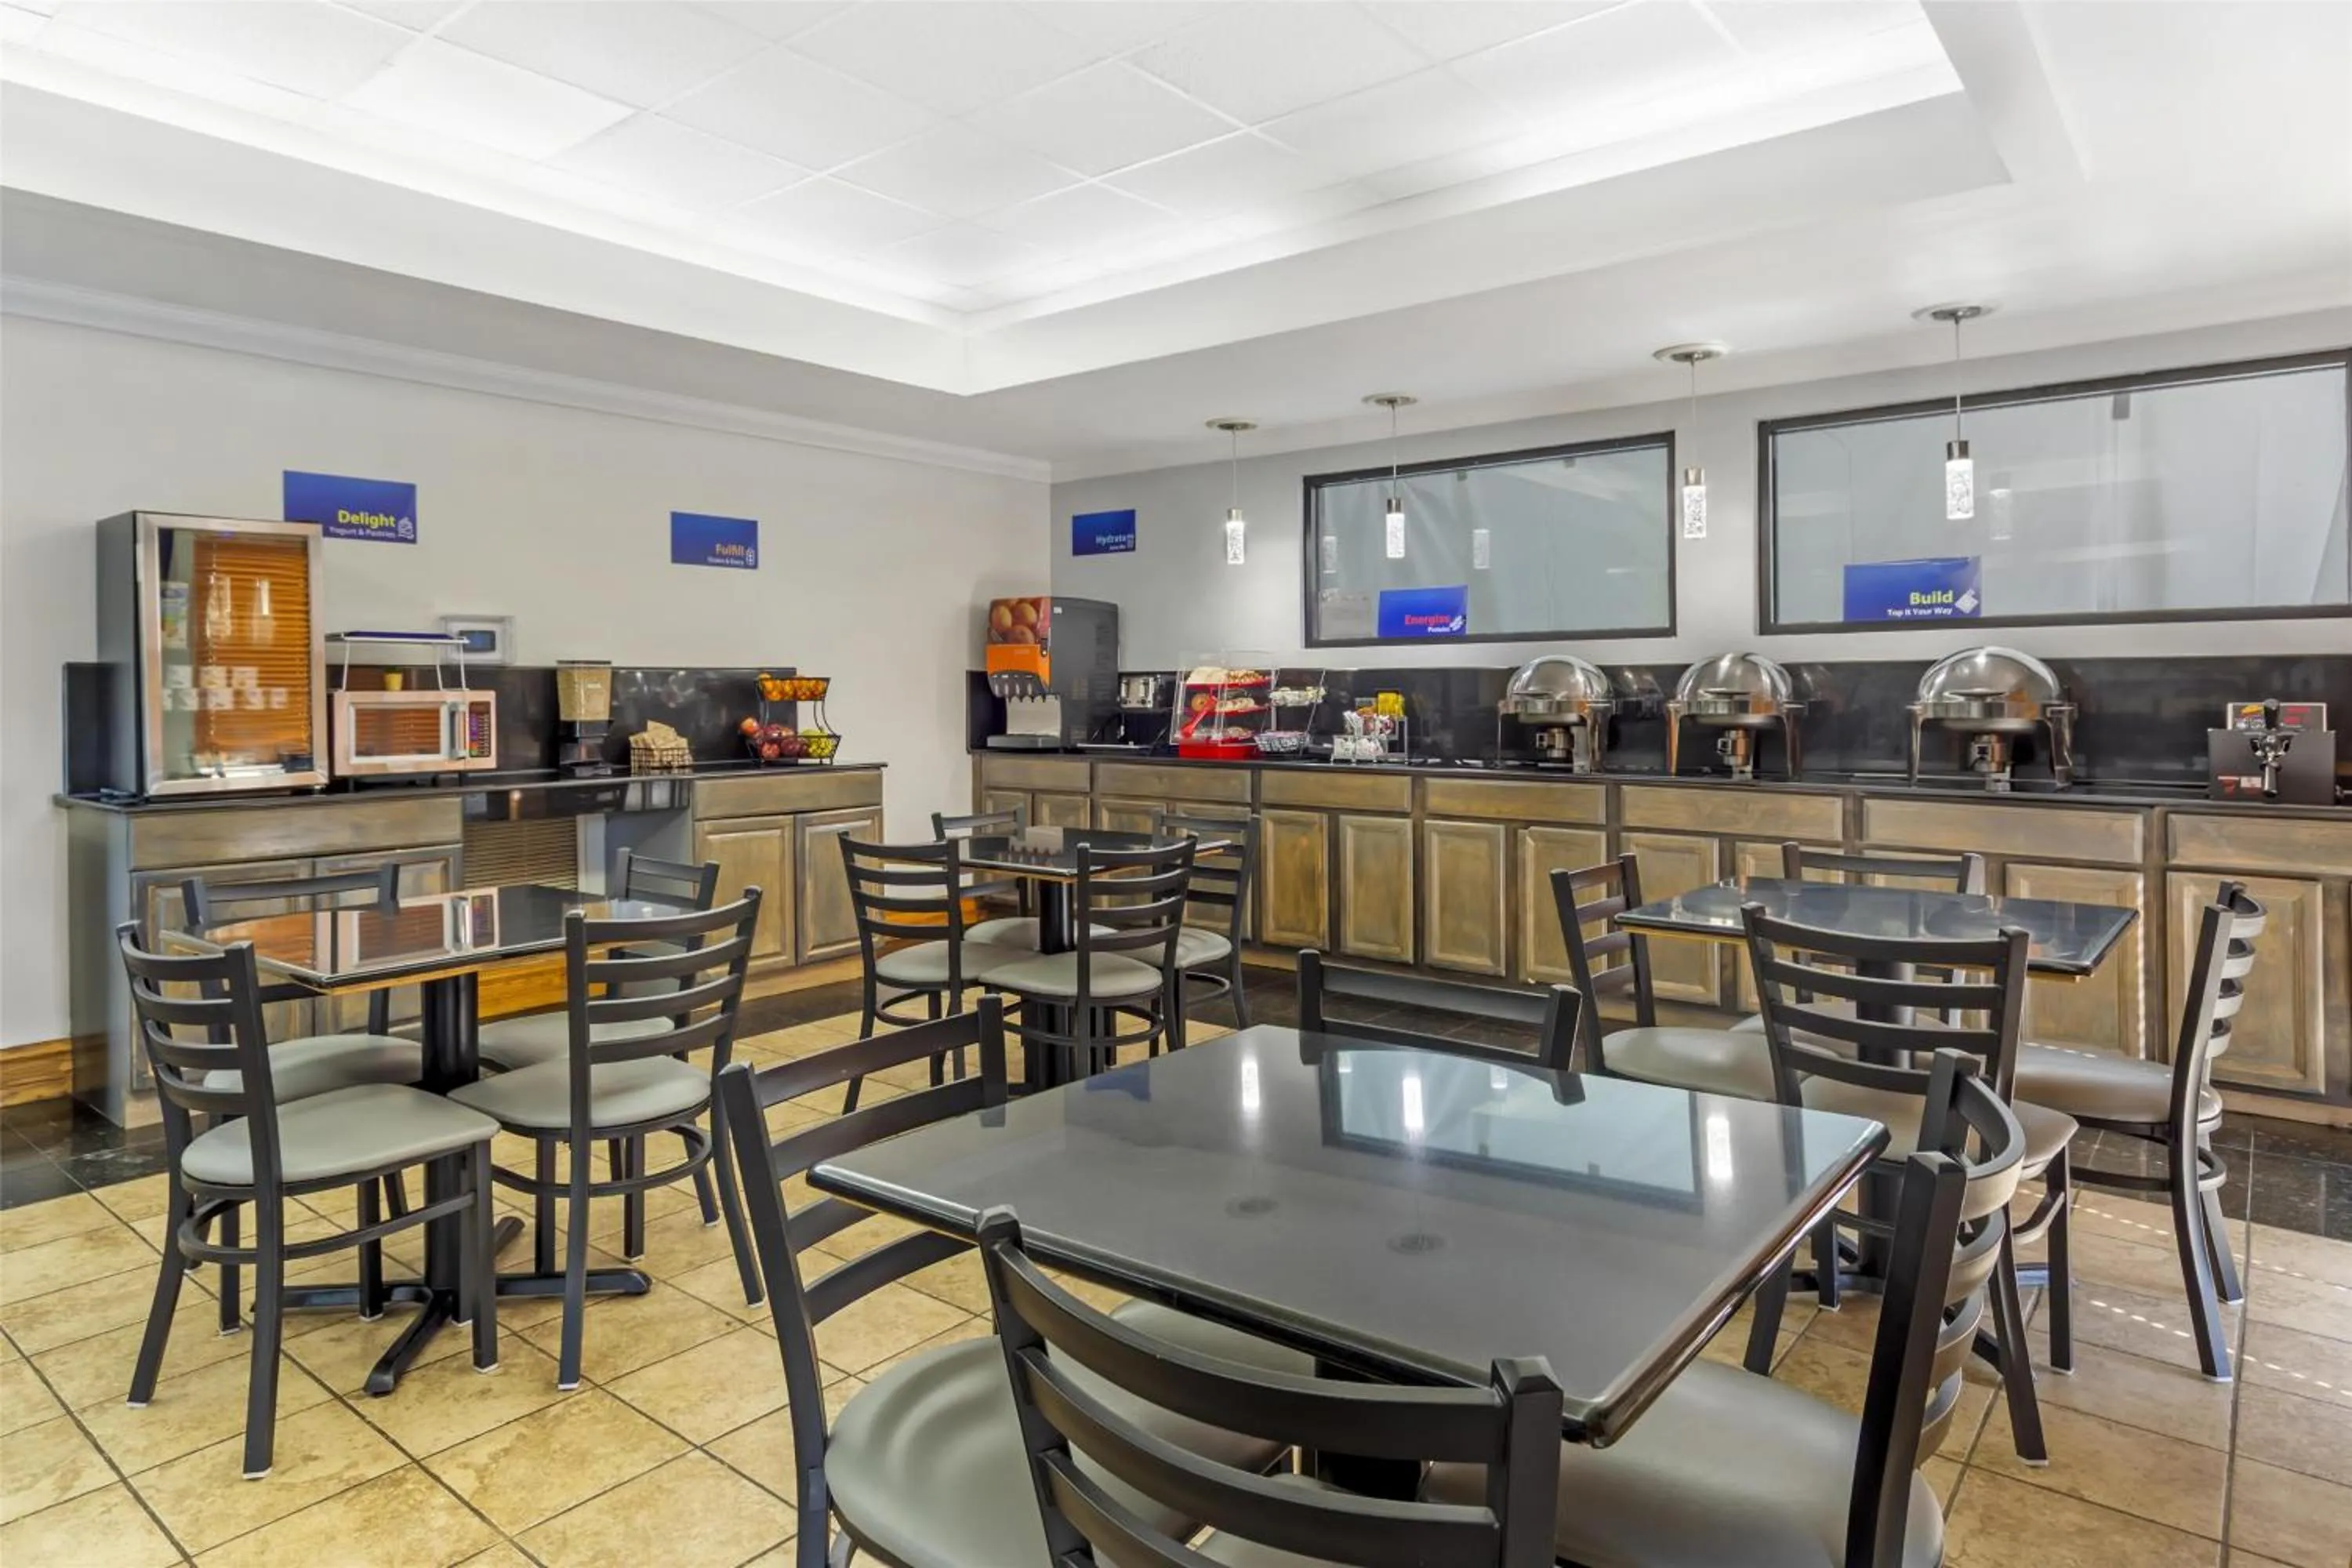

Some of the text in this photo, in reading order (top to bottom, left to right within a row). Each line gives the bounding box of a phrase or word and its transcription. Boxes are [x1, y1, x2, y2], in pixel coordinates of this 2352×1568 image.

[338, 510, 396, 529] Delight
[328, 526, 357, 536] Yogurt
[1909, 590, 1954, 605] Build
[1934, 607, 1953, 615] Way
